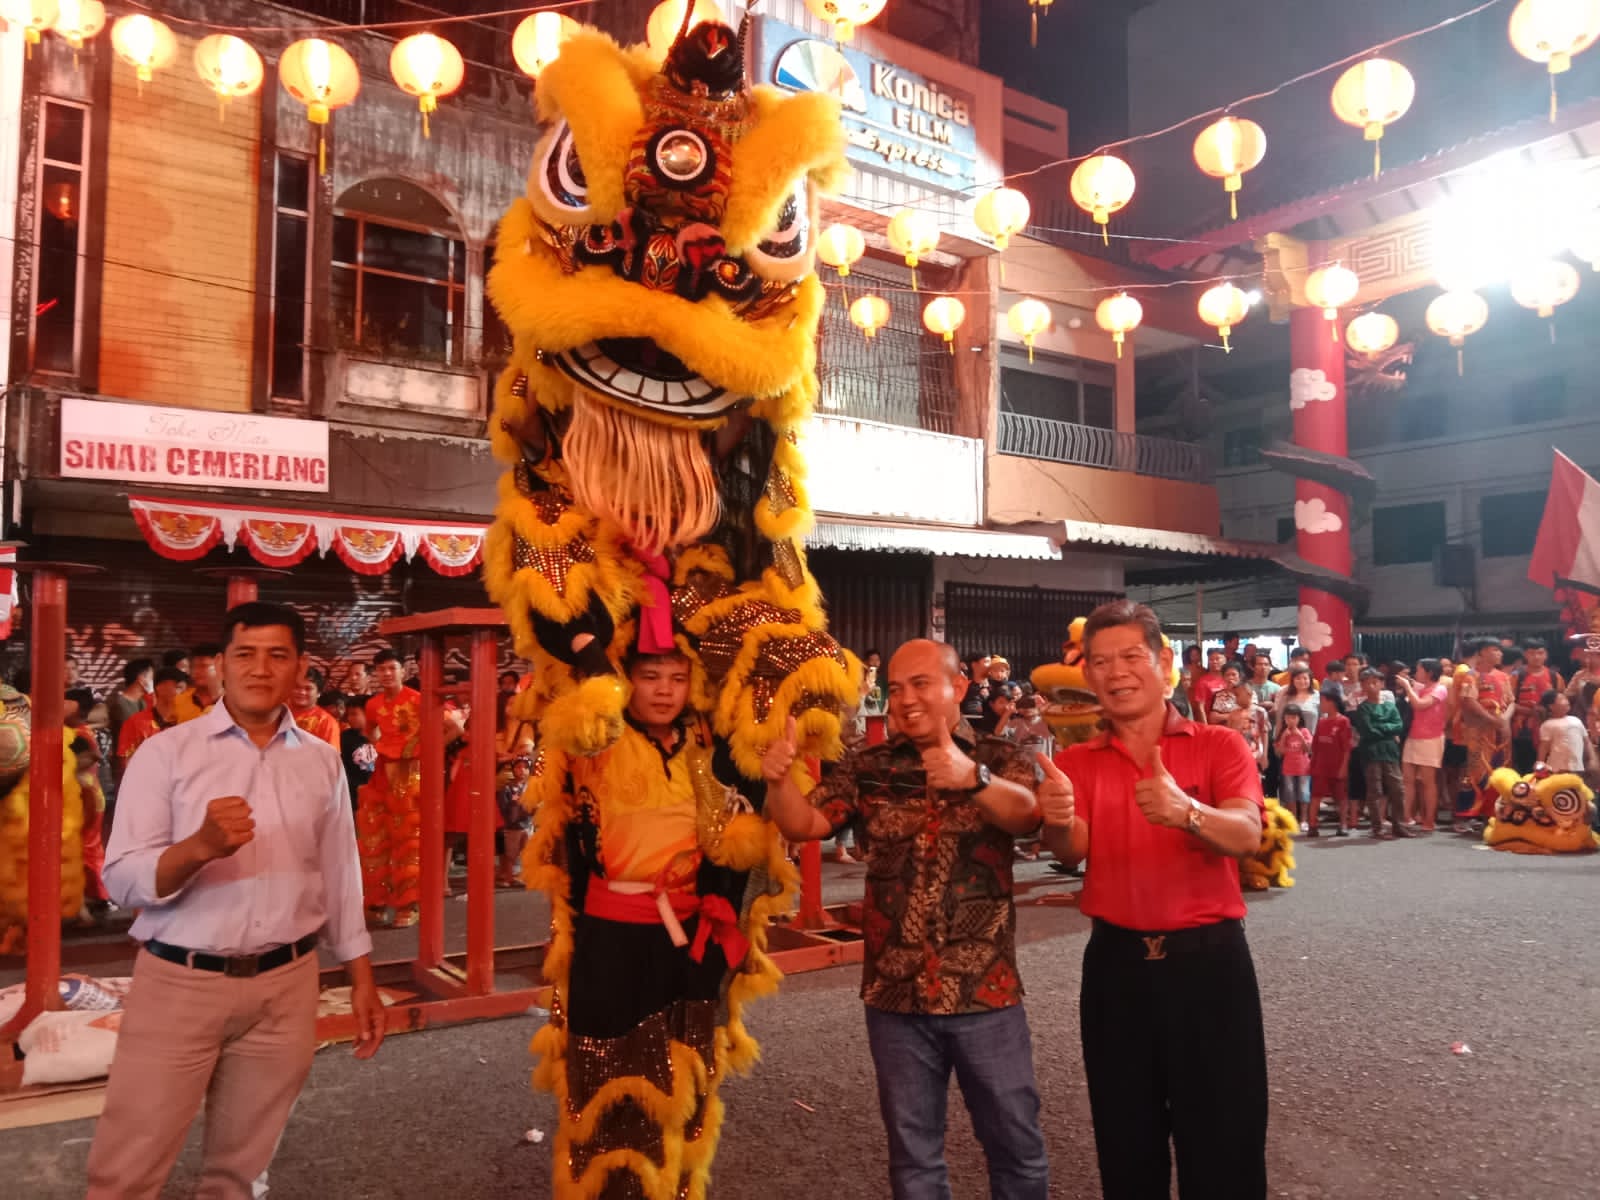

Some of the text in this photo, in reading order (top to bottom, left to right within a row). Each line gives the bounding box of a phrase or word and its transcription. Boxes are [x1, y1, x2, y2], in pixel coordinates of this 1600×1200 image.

[870, 63, 969, 126] Konica
[893, 107, 952, 144] FILM
[861, 128, 957, 175] Express
[65, 440, 326, 485] SINAR CEMERLANG
